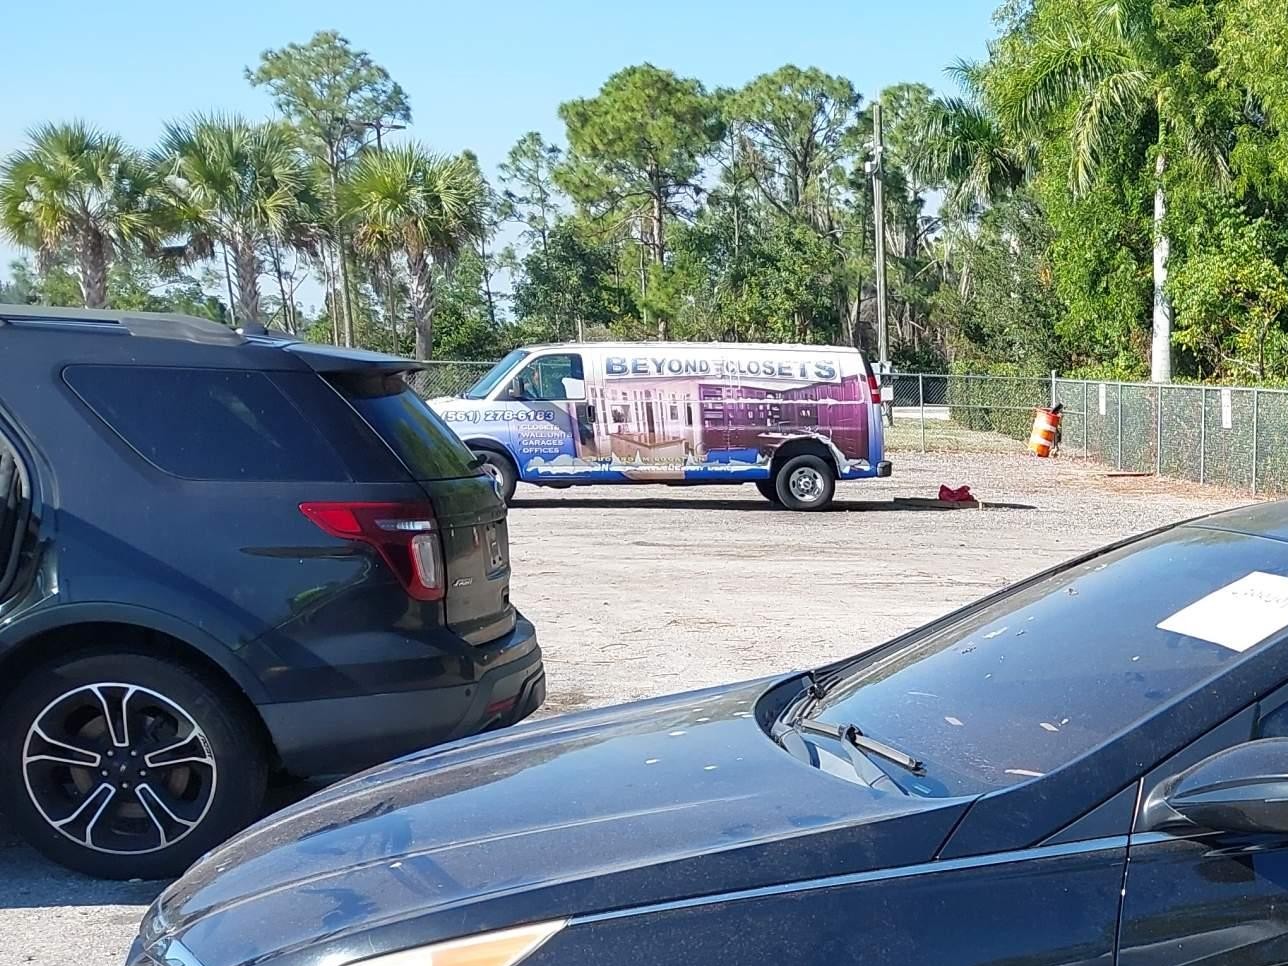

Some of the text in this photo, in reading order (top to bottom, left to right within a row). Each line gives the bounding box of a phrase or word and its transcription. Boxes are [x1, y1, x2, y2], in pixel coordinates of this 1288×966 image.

[605, 356, 709, 376] BEYOND
[725, 359, 838, 380] CLOSETS
[441, 409, 554, 424] (561) 278-6183
